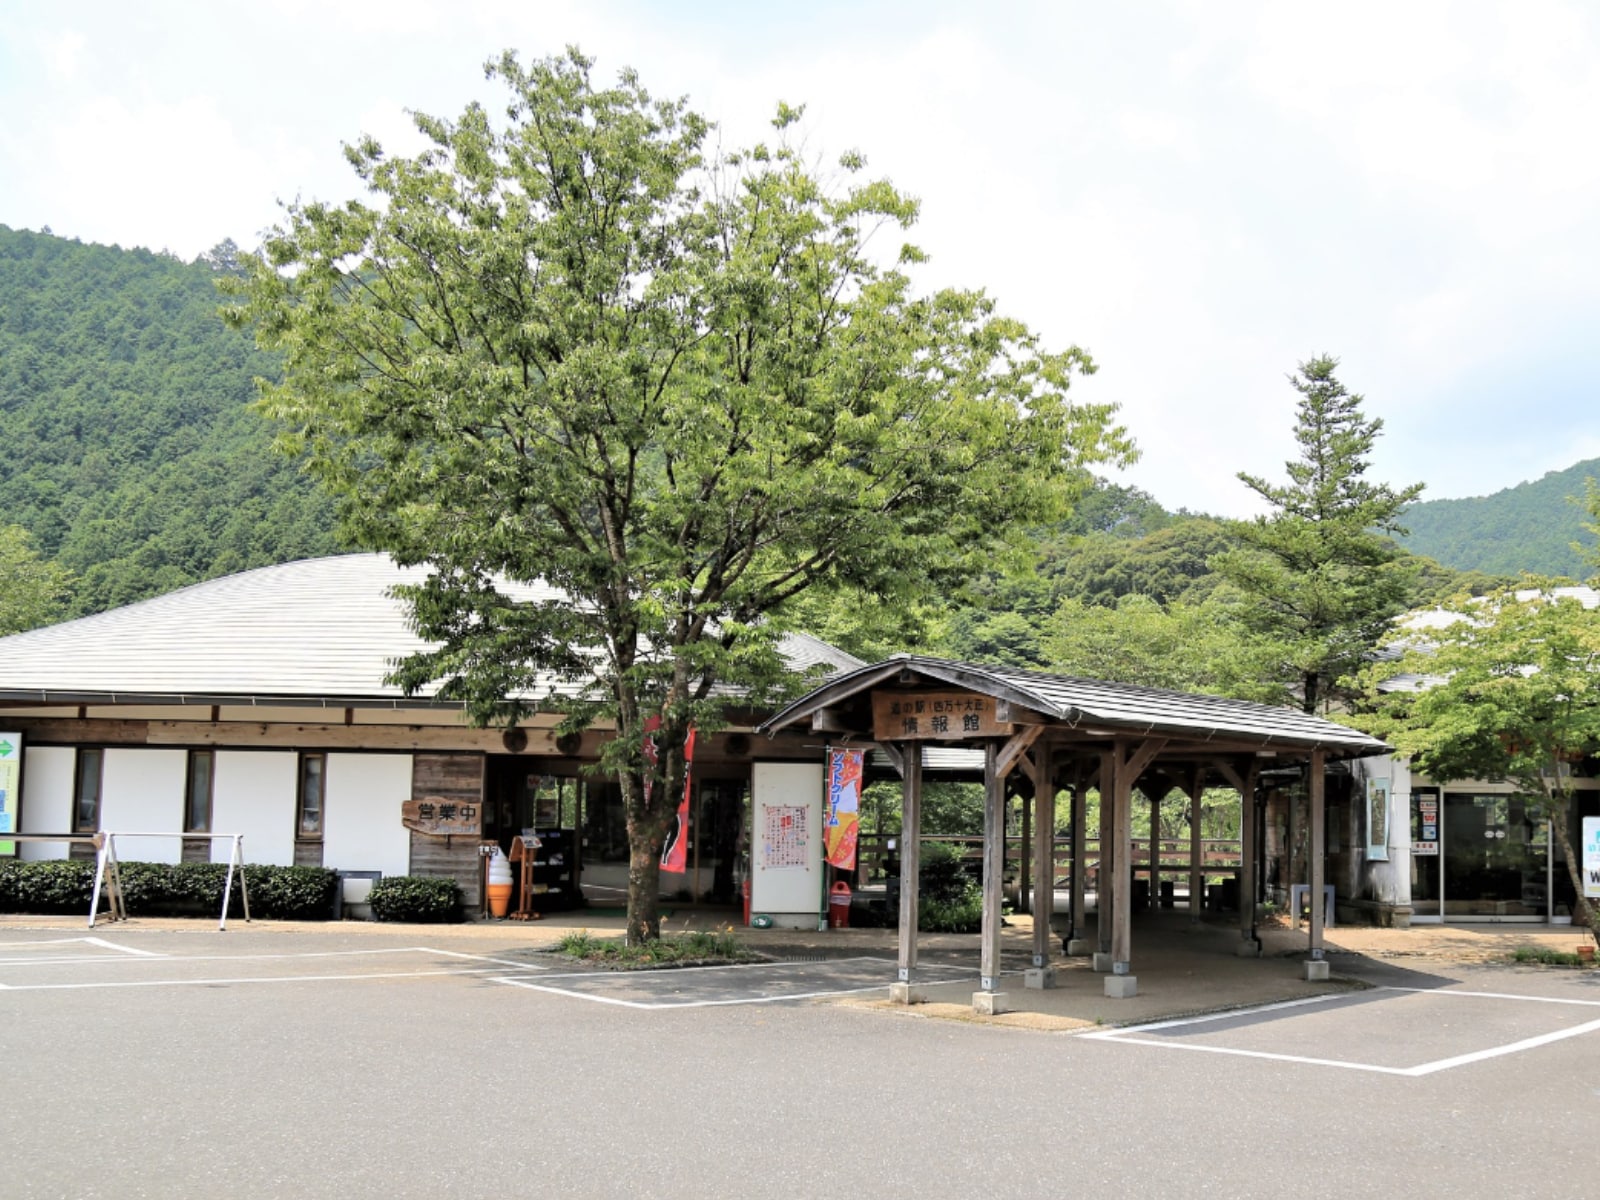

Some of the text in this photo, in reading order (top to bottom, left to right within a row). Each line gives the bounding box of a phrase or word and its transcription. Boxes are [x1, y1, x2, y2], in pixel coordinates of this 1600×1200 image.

[902, 714, 980, 735] 情報館
[829, 753, 844, 826] ソフトクリーム
[418, 803, 476, 821] 営業中
